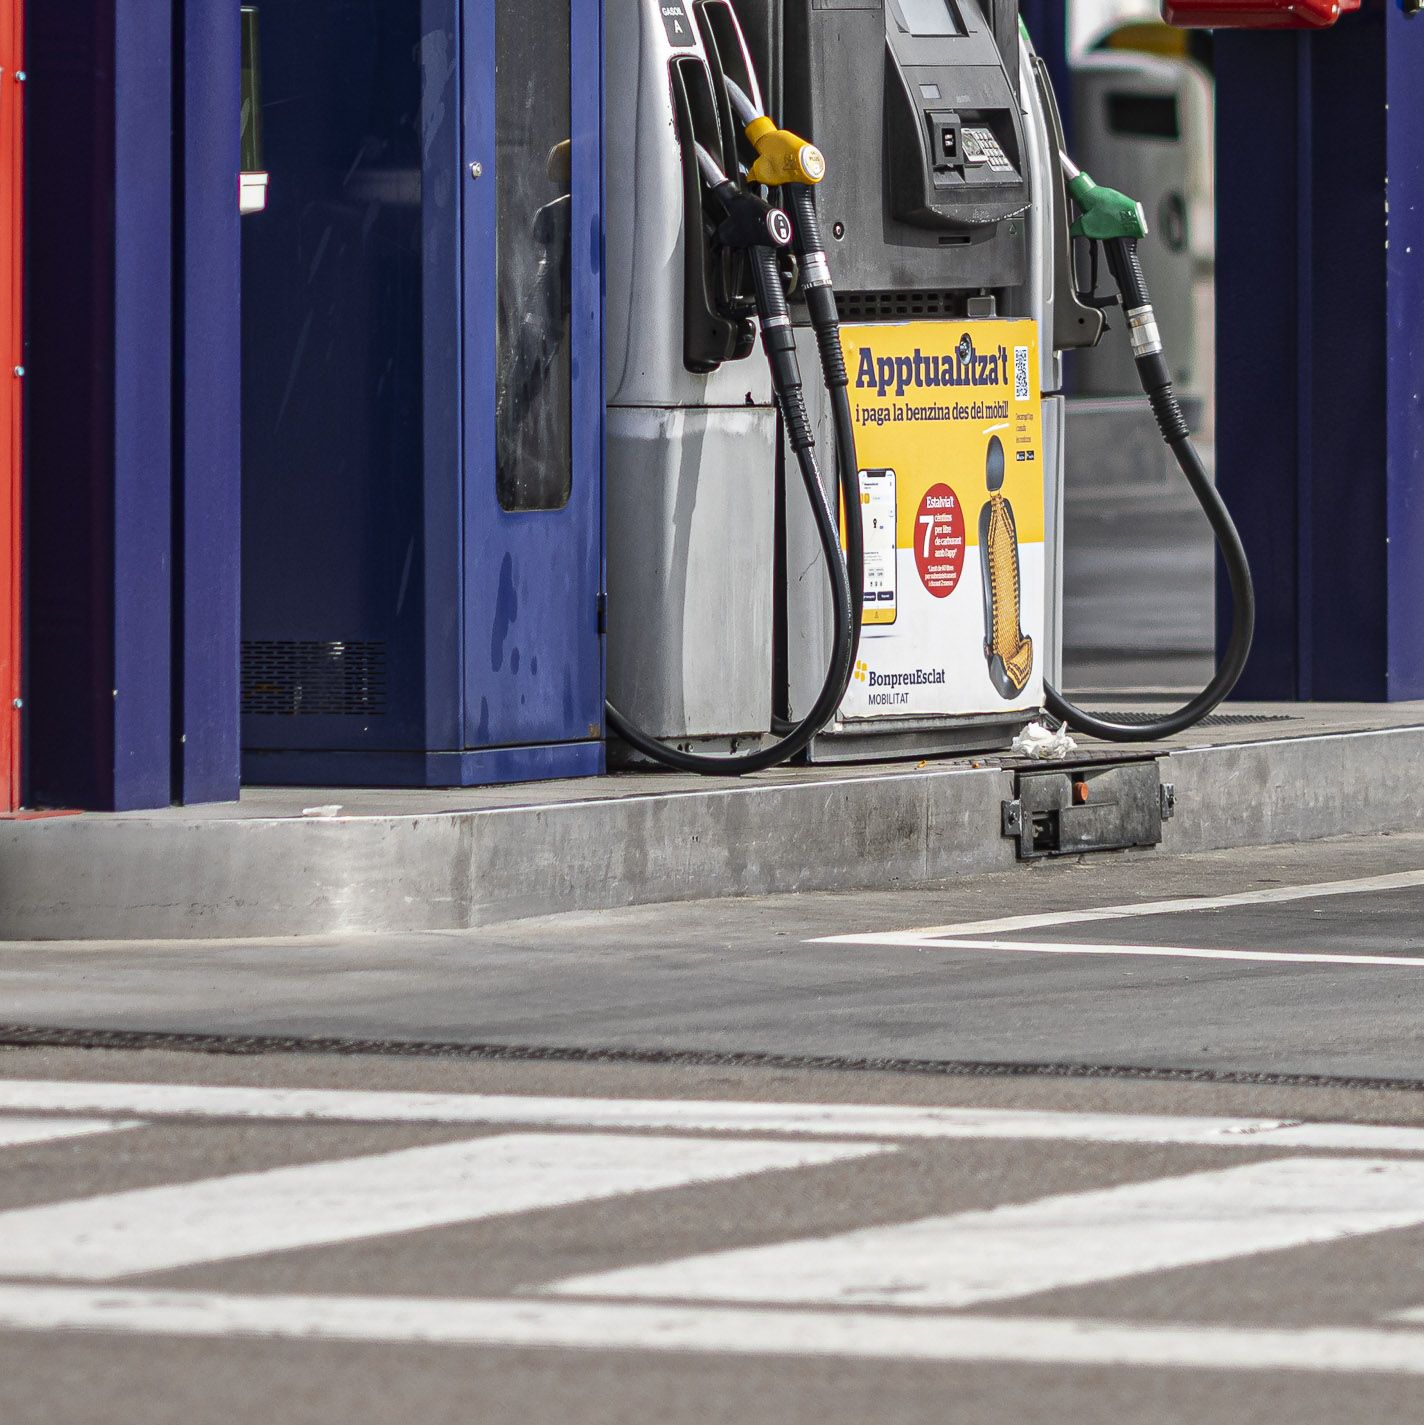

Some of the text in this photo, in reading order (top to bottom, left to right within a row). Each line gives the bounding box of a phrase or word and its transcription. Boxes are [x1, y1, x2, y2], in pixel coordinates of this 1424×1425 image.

[673, 19, 684, 35] A
[862, 407, 890, 426] paga
[893, 403, 904, 422] la
[905, 402, 952, 421] benzina
[952, 401, 970, 420] des
[971, 400, 985, 419] del
[919, 514, 935, 558] 7
[869, 668, 946, 689] BonpreuEsclat
[869, 692, 909, 706] MOBILITAT
